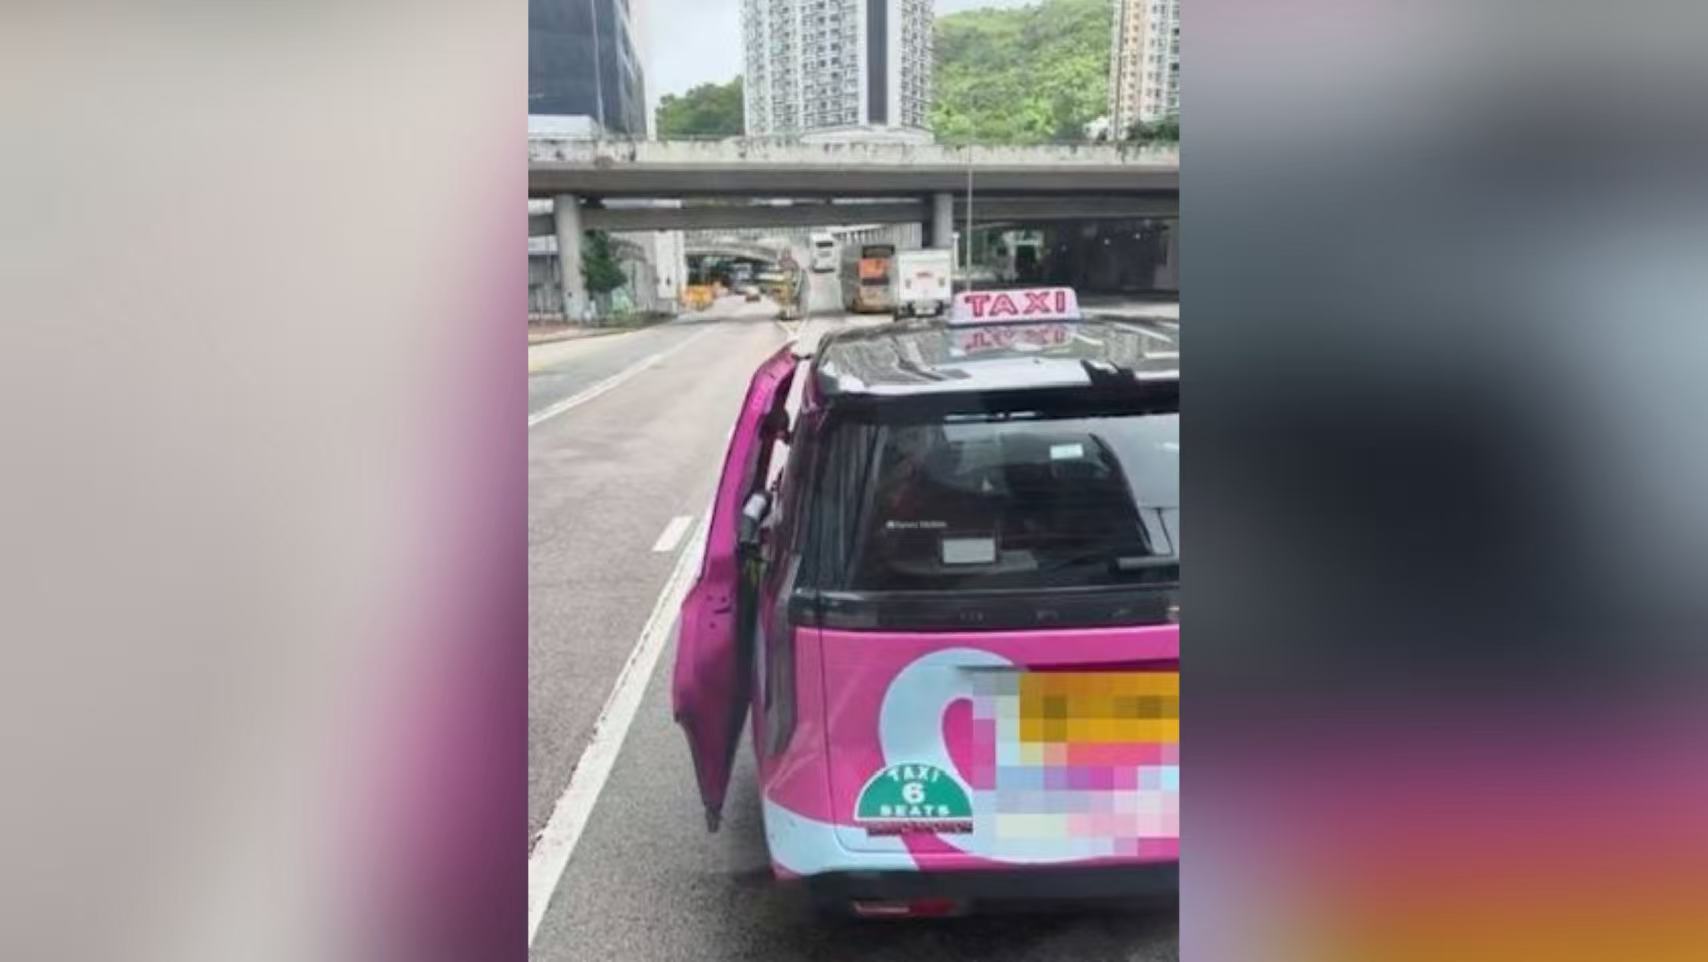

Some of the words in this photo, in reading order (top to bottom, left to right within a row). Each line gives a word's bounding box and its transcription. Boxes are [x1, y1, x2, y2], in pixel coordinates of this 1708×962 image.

[964, 291, 1065, 317] TAXI
[887, 765, 939, 782] TAXI
[902, 782, 926, 805] 6
[880, 804, 951, 818] SEATS
